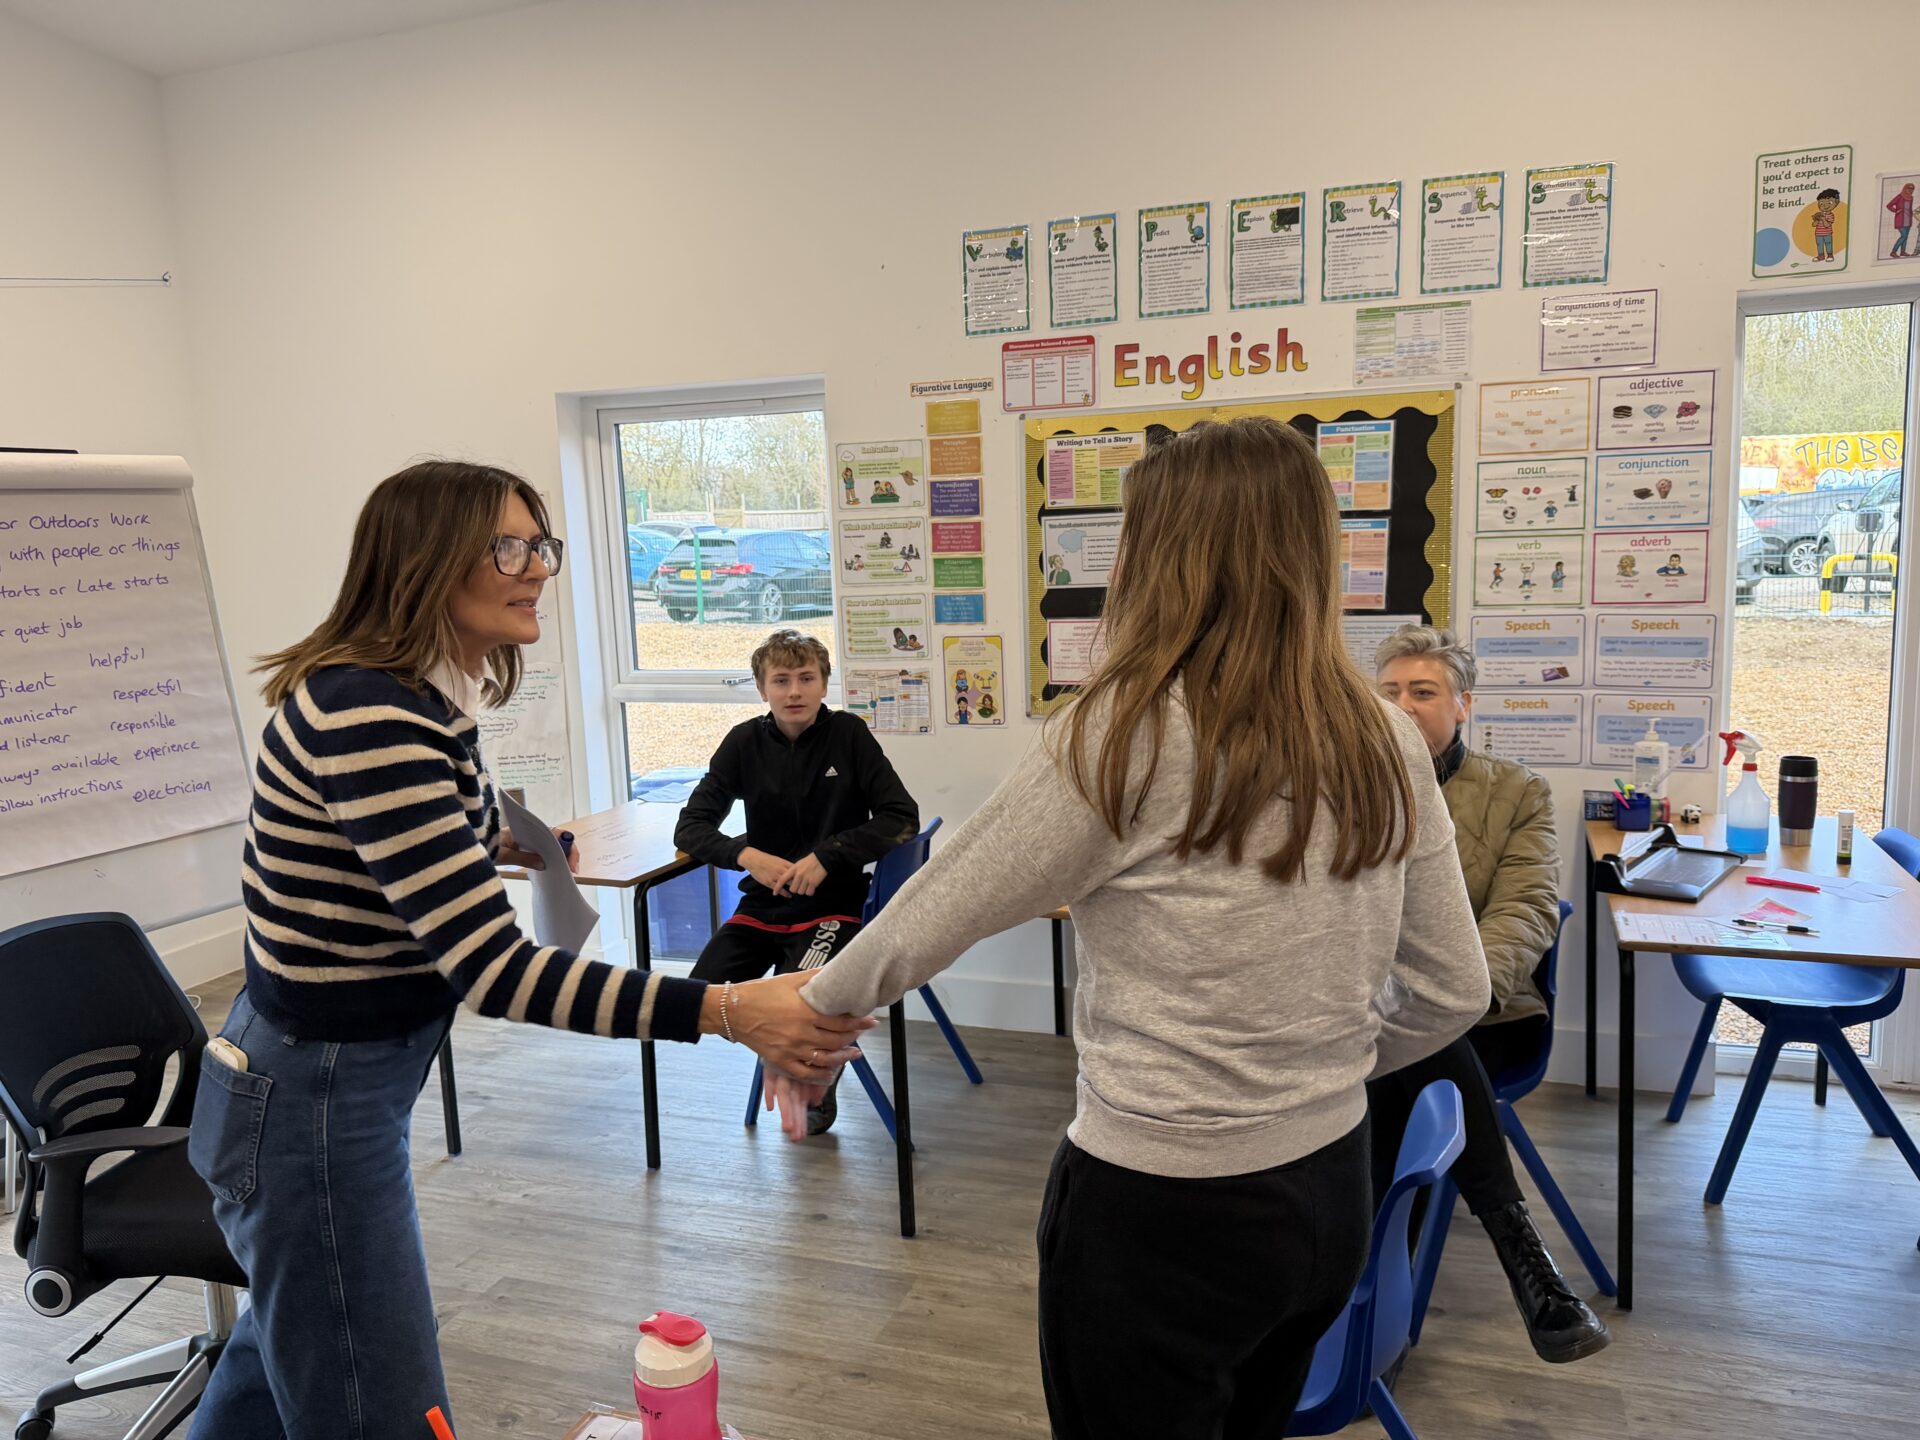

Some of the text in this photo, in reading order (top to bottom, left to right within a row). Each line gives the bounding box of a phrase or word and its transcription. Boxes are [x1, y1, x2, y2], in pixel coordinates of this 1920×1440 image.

[1763, 152, 1845, 169] Treat others as
[1762, 165, 1844, 184] you'd expect to
[1762, 181, 1821, 195] be treated.
[1428, 191, 1467, 214] Sequence
[1762, 197, 1805, 210] Be kind.
[1330, 201, 1364, 223] Retrieve
[1555, 297, 1645, 312] conjunctions of time
[1114, 327, 1308, 400] English
[911, 381, 992, 394] Figurative Language
[1629, 377, 1684, 392] adjective
[1057, 439, 1083, 447] Writing
[1795, 440, 1849, 466] THE
[1517, 466, 1546, 475] noun
[1618, 457, 1689, 472] conjunction
[29, 515, 99, 530] Outdoors
[111, 513, 151, 526] Work
[1517, 540, 1542, 550] verb
[1630, 535, 1672, 547] adverb
[10, 537, 181, 566] with people or things
[0, 575, 169, 598] tarts or Late starts
[14, 623, 50, 643] quiet
[59, 616, 83, 638] job
[1505, 619, 1551, 634] Speech
[1631, 619, 1679, 632] Speech
[90, 648, 145, 669] helpful
[0, 673, 56, 698] fident
[113, 679, 182, 701] respectful
[1503, 698, 1549, 711] Speech
[1628, 699, 1675, 713] Speech
[110, 712, 176, 732] responsible
[16, 734, 71, 750] listener
[135, 741, 200, 762] experience
[51, 753, 121, 772] available
[0, 778, 124, 813] ollow instructions
[133, 780, 212, 803] electrician
